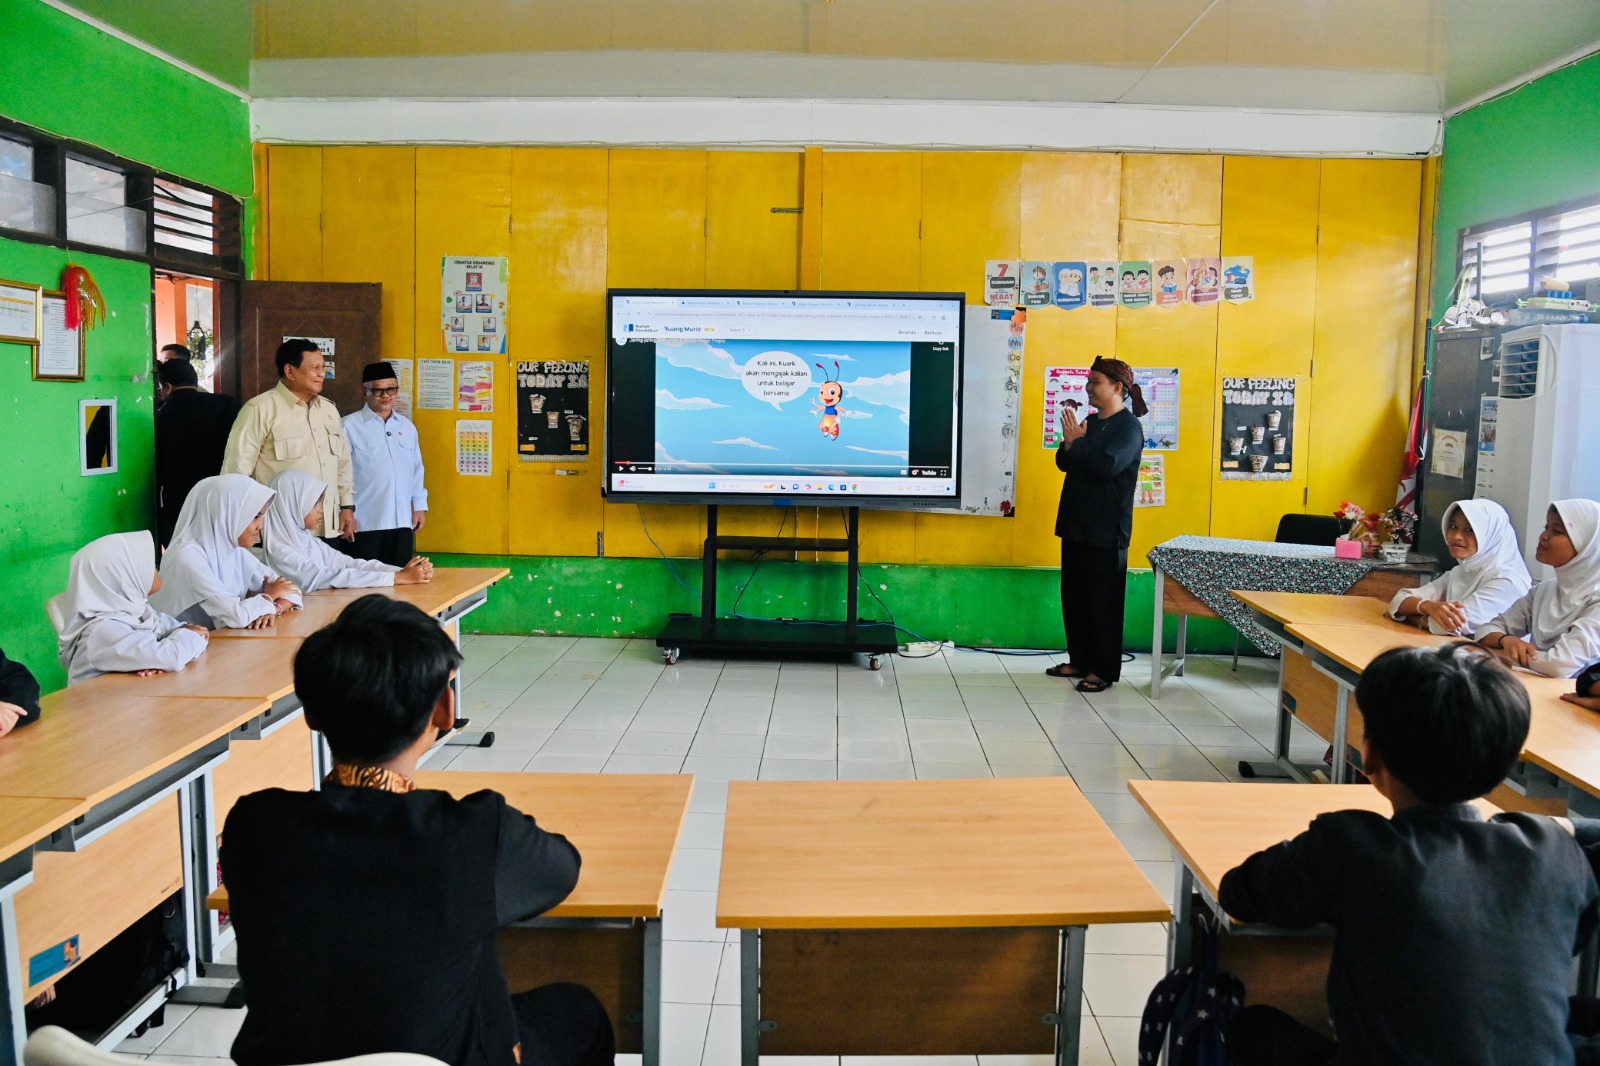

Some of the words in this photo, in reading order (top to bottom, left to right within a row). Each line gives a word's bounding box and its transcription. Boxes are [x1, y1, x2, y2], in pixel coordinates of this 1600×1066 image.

[997, 263, 1009, 278] 7
[1009, 353, 1021, 362] Oo
[517, 361, 539, 373] OUR
[543, 360, 589, 374] FEELING
[760, 370, 790, 378] mengajak
[517, 373, 566, 388] TODAY
[775, 380, 796, 388] belajar
[1223, 377, 1246, 389] OUR
[1247, 378, 1295, 390] FEELING
[1006, 383, 1018, 393] Qq
[1223, 389, 1270, 406] TODAY
[1005, 427, 1014, 435] Tt
